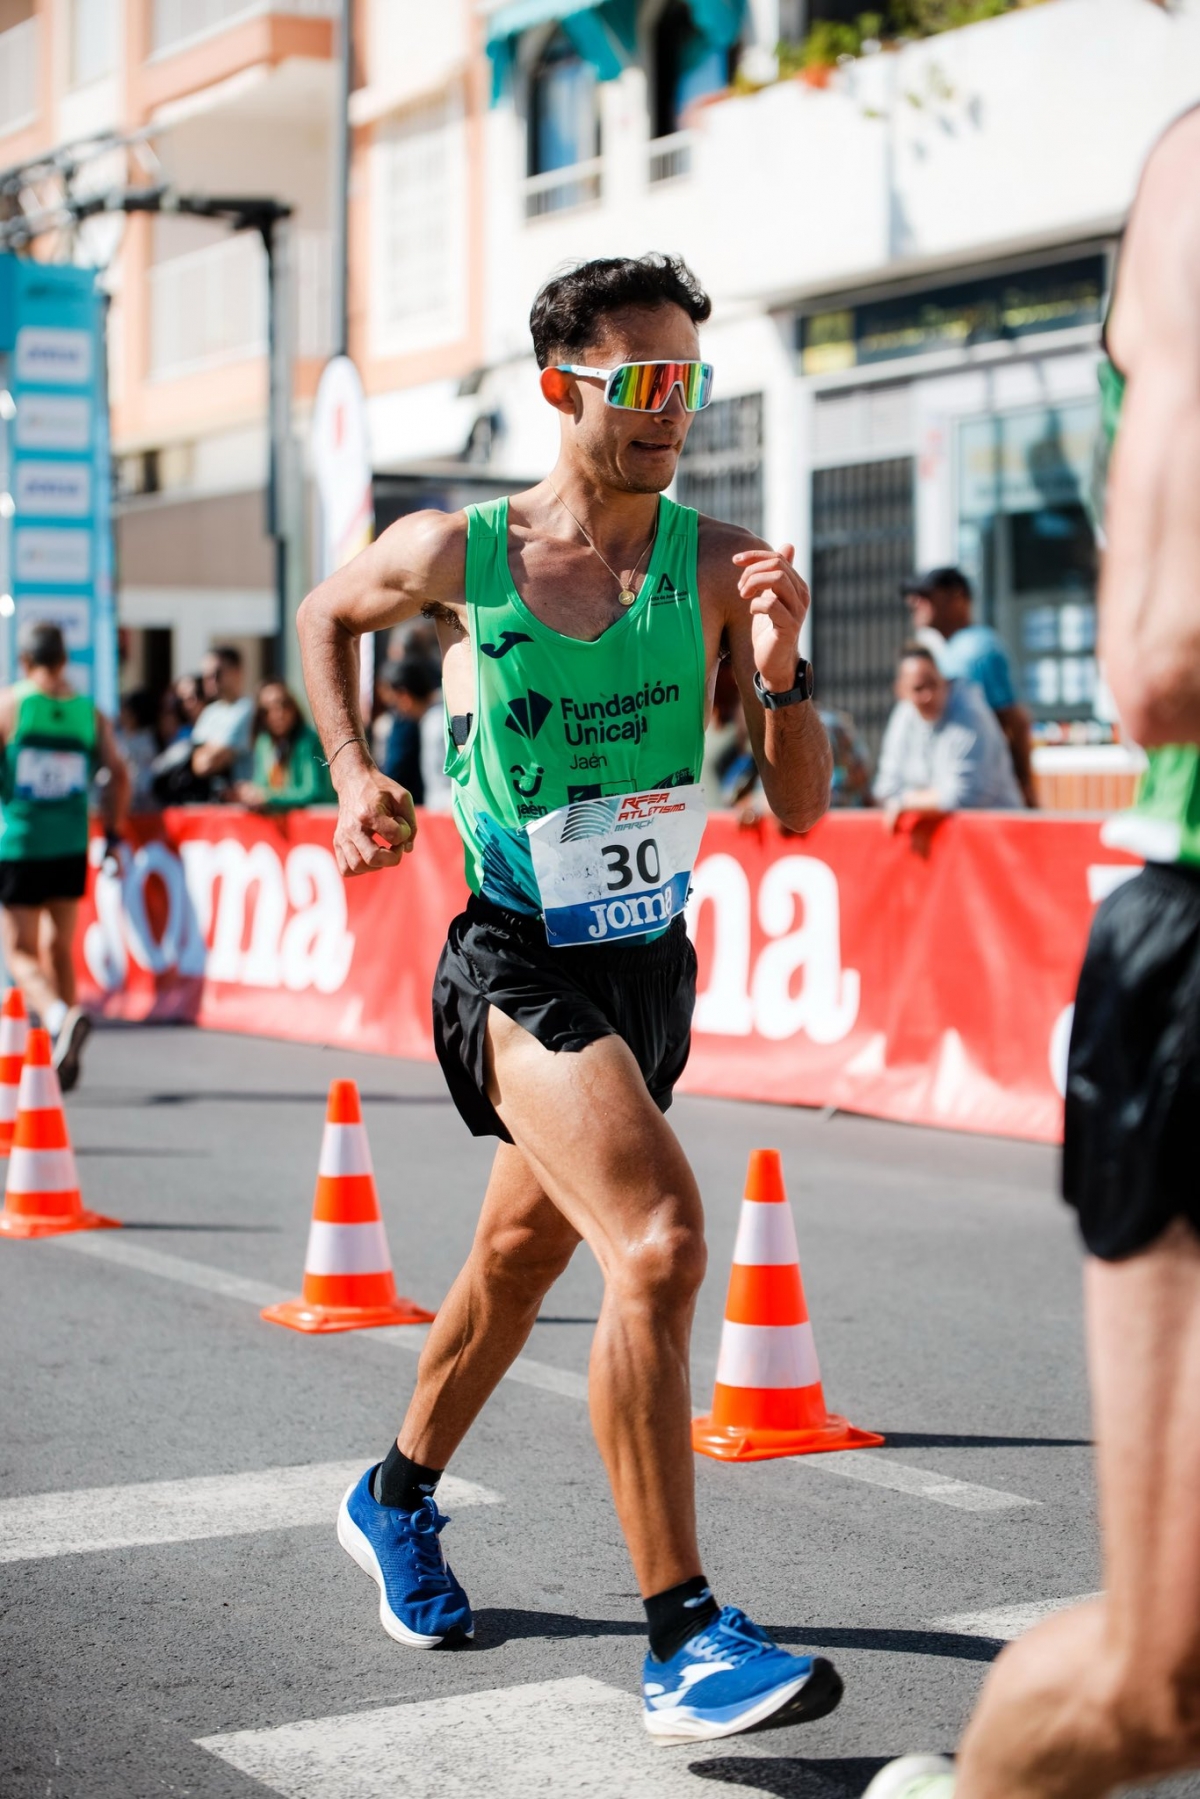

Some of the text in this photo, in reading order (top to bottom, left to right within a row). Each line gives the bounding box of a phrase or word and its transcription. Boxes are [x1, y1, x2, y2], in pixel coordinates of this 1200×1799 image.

[560, 680, 679, 721] Fundación
[569, 752, 608, 770] Jaén
[621, 792, 670, 809] RFEA
[617, 803, 686, 821] ATLETISMO
[601, 838, 661, 891] 30
